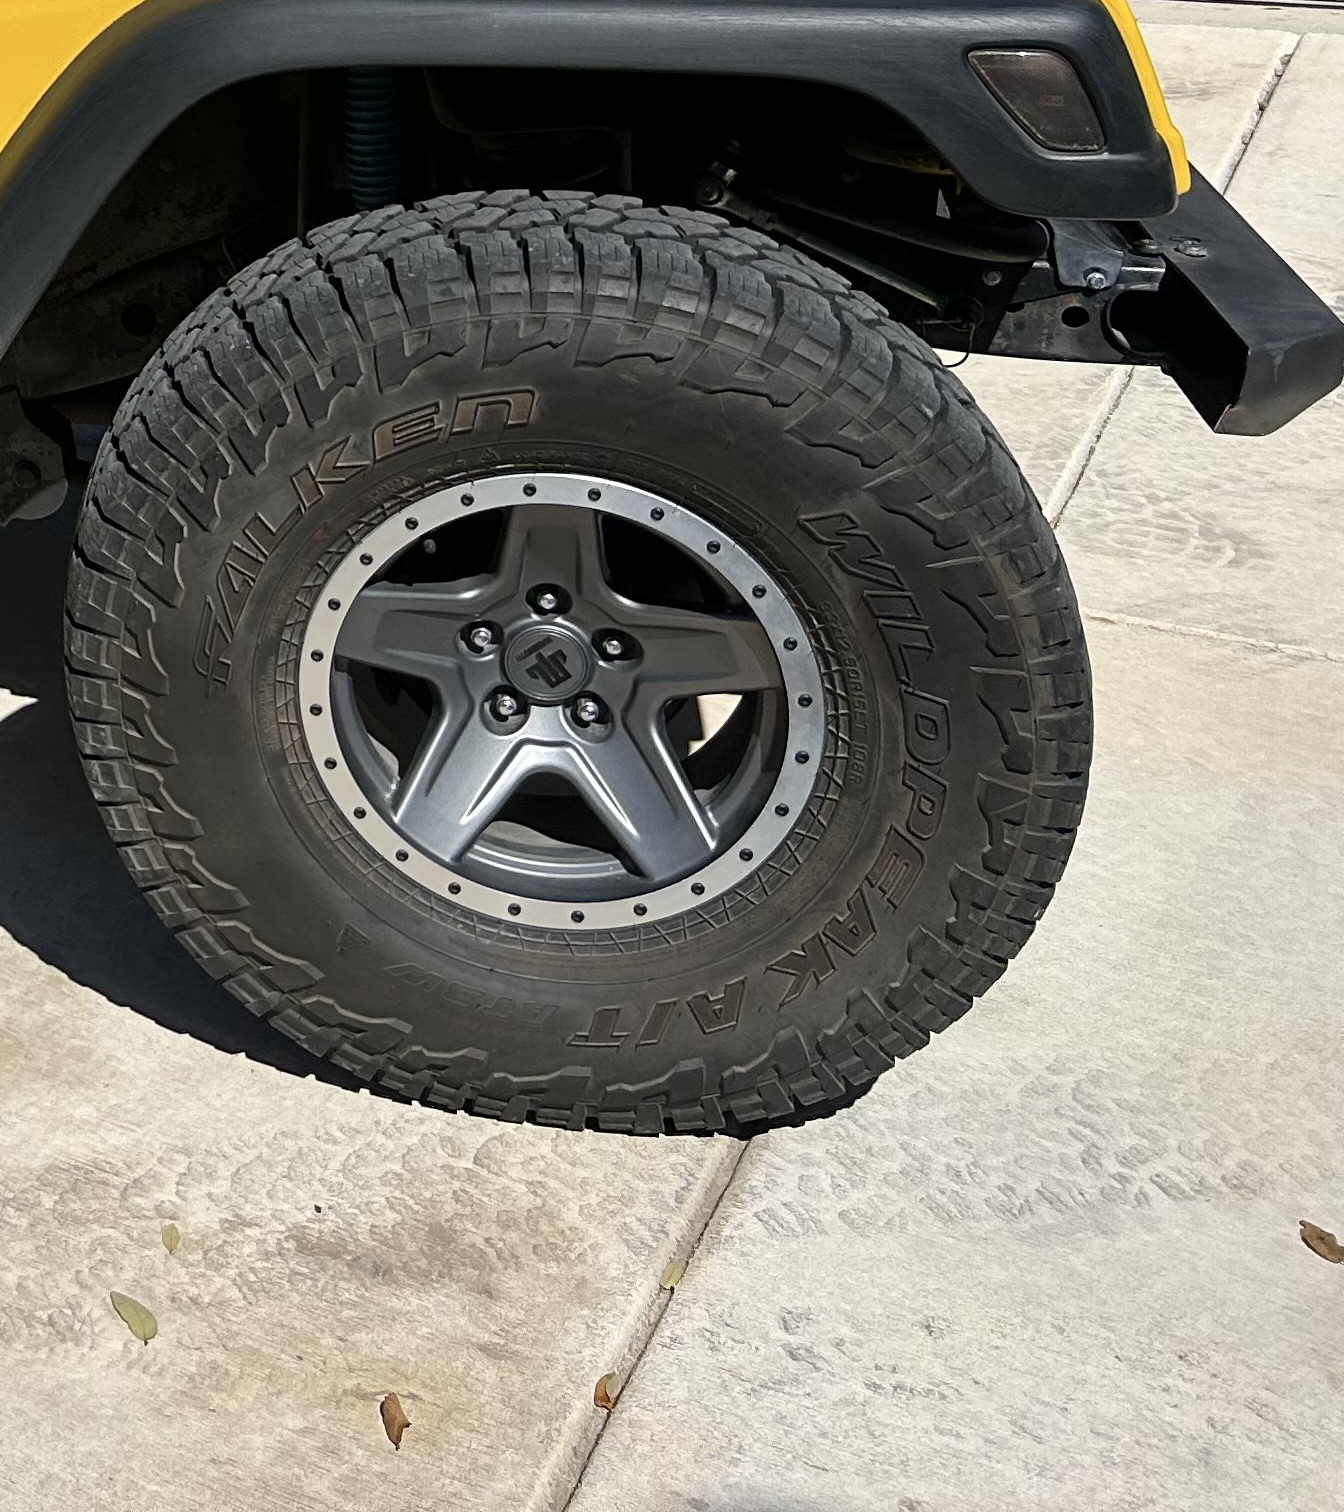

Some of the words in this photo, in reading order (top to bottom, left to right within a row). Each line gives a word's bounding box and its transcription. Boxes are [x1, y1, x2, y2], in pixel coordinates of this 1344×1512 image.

[194, 387, 540, 700] FALKEN
[765, 510, 952, 1009] WILDPEAK
[563, 976, 749, 1048] A/T
